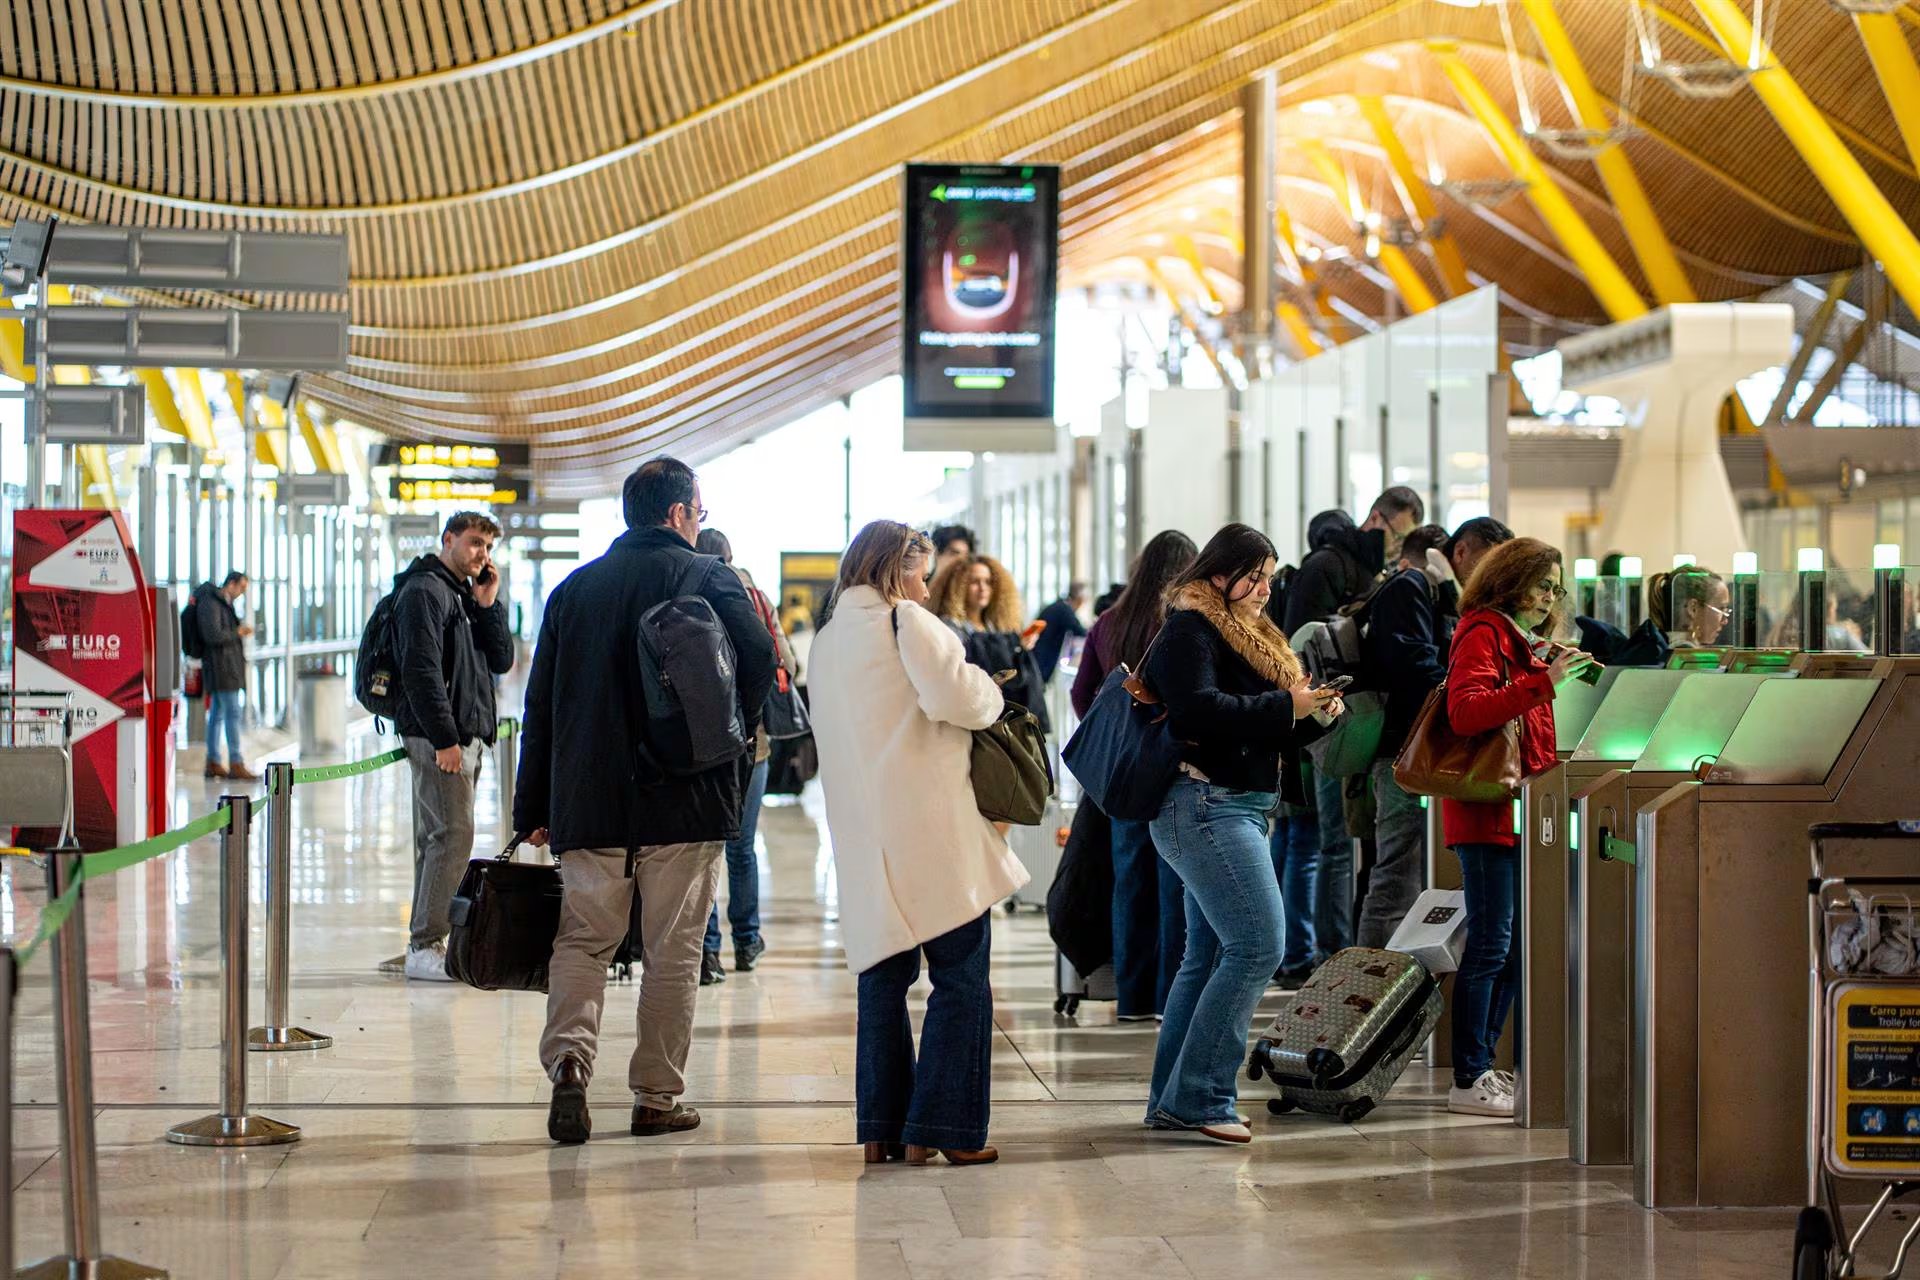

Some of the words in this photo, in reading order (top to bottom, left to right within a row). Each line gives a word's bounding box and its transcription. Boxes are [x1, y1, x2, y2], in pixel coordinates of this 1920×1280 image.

[89, 548, 119, 560] EURO
[72, 634, 120, 650] EURO
[1870, 1006, 1897, 1017] Carro
[1878, 1017, 1907, 1029] Trolley
